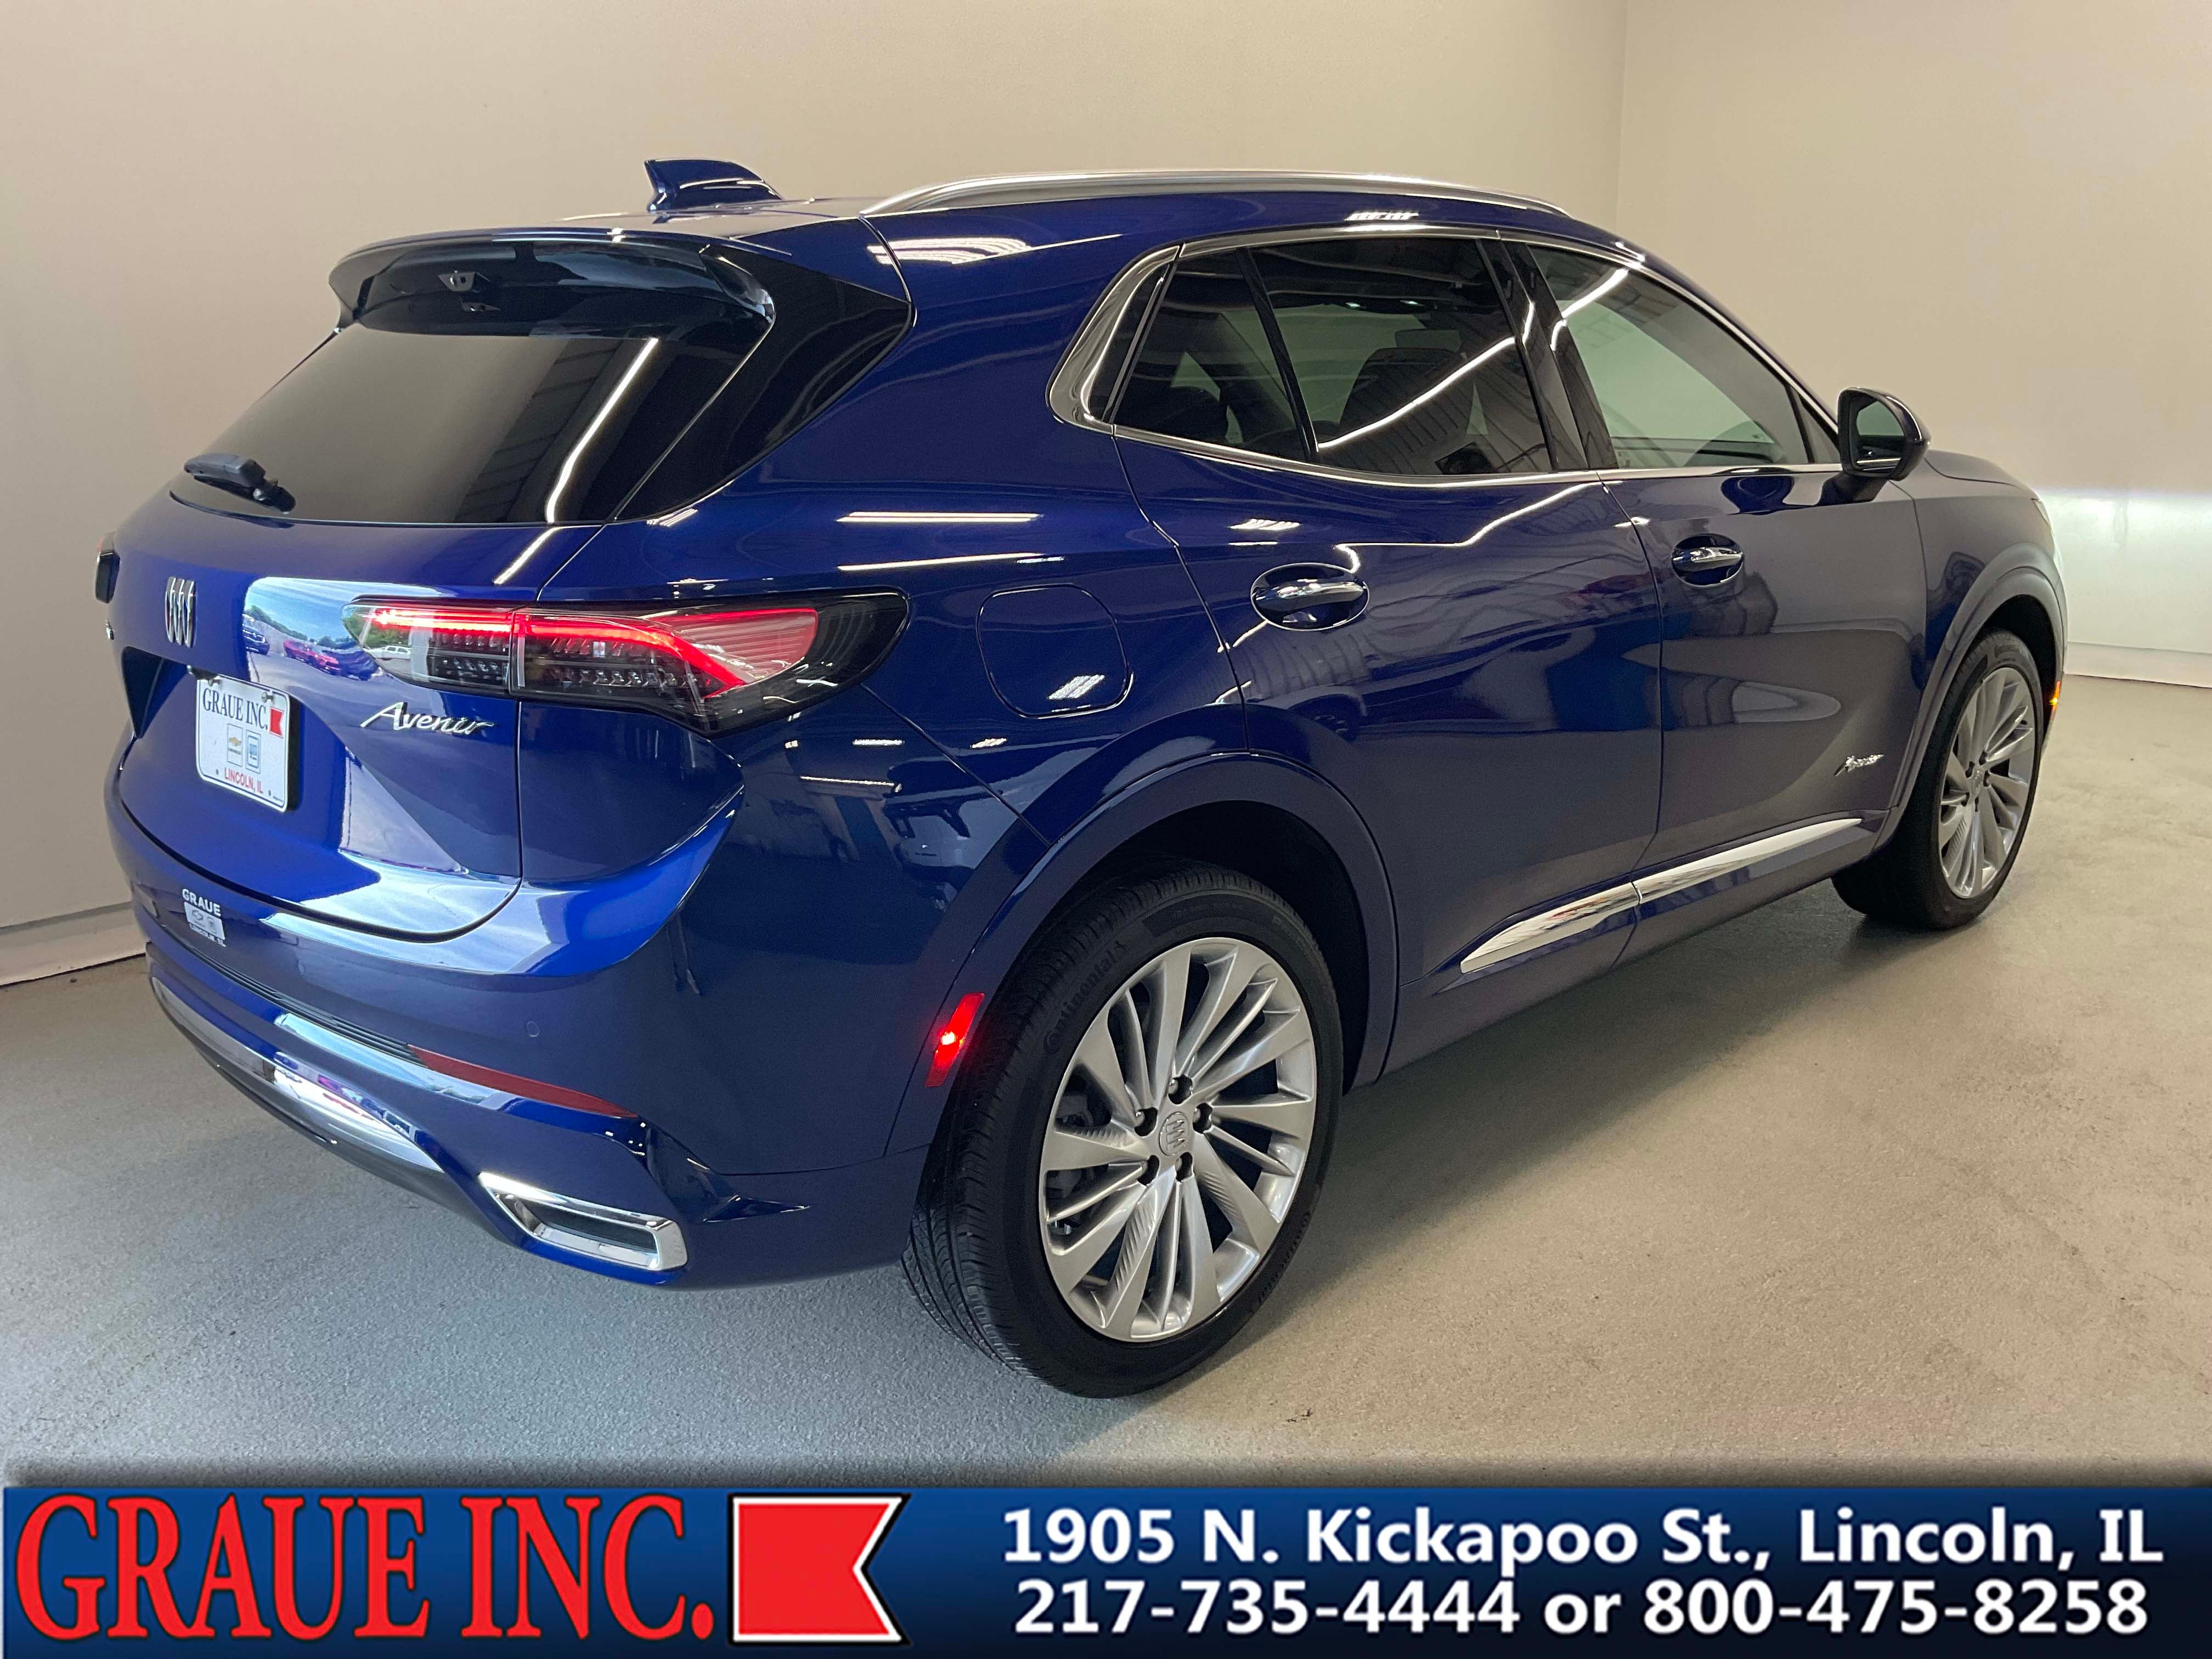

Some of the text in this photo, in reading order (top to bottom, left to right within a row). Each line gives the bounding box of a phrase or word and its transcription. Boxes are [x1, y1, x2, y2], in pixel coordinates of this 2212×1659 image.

[202, 688, 268, 730] GRAUE INC.
[360, 702, 494, 735] Avenir
[224, 767, 263, 794] LINCOLN, IL
[182, 889, 221, 917] GRAUE
